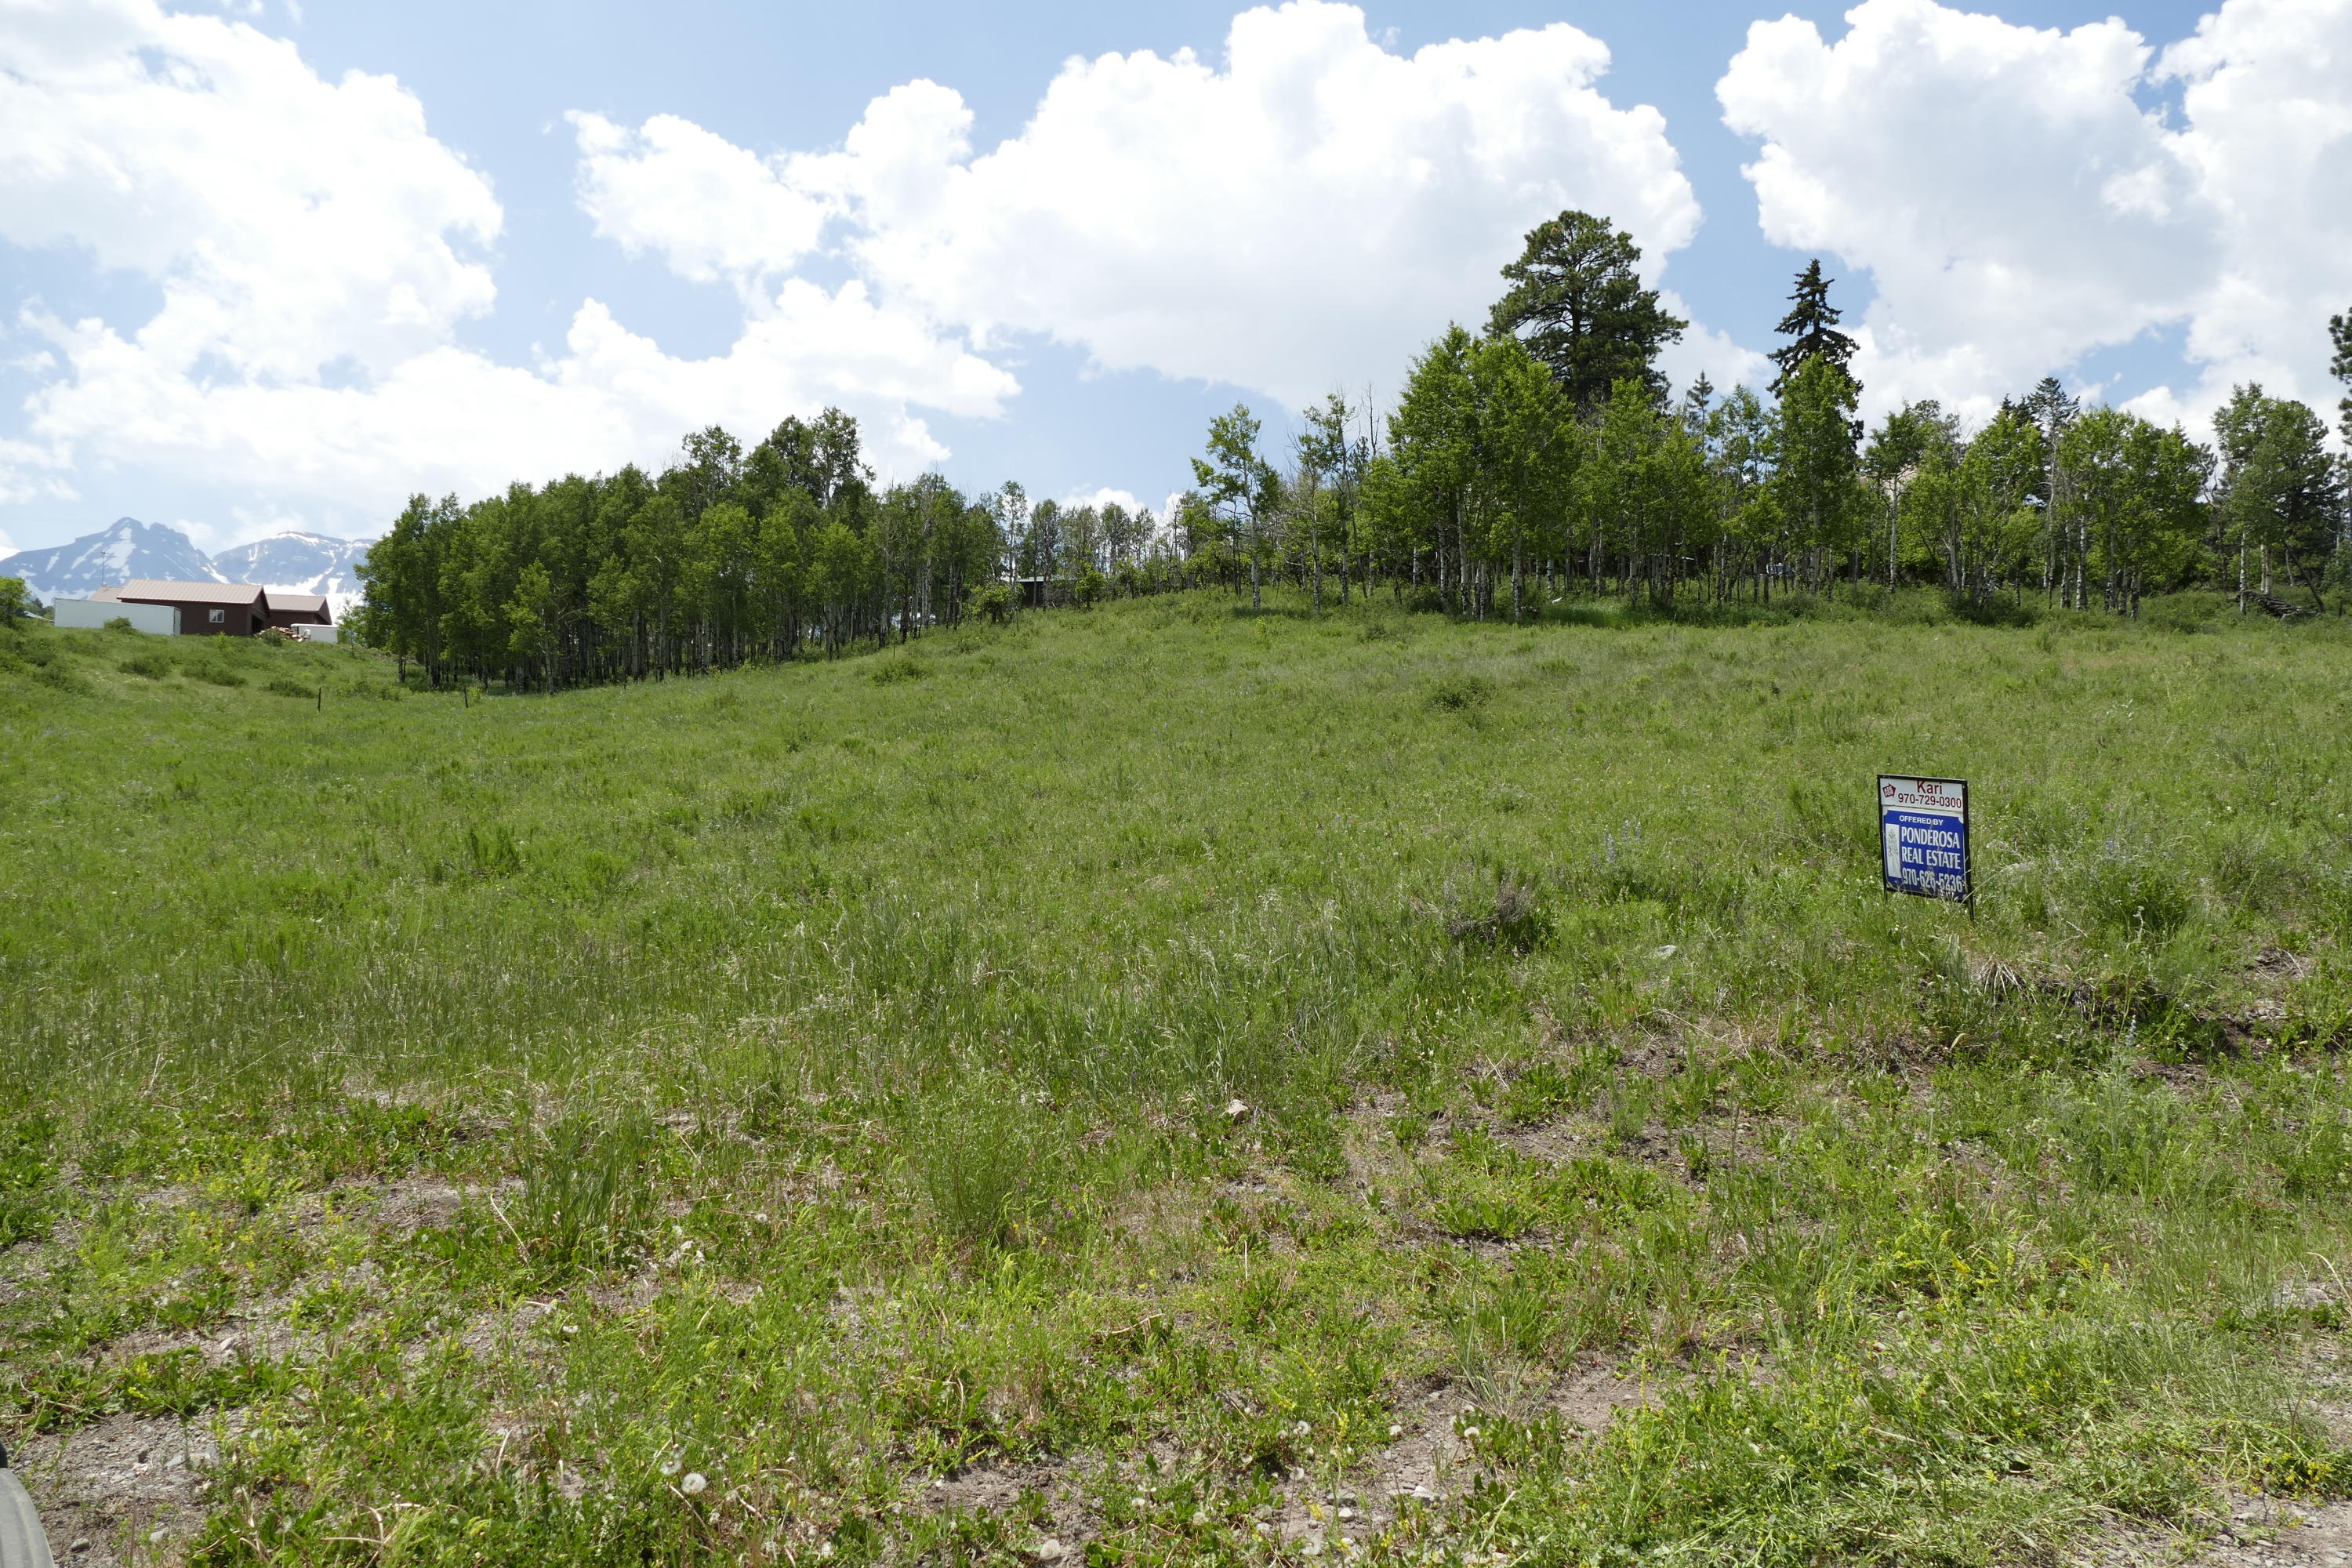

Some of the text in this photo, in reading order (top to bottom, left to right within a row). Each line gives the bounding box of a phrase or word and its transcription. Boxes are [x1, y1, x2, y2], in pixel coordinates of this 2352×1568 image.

[1918, 781, 1942, 794] Kari
[1898, 793, 1962, 808] 970-729-0300
[1900, 815, 1930, 824] OFFERED
[1902, 827, 1960, 848] PONDEROSA
[1902, 847, 1961, 869] REAL ESTATE
[1903, 868, 1962, 892] 970-626-5236
